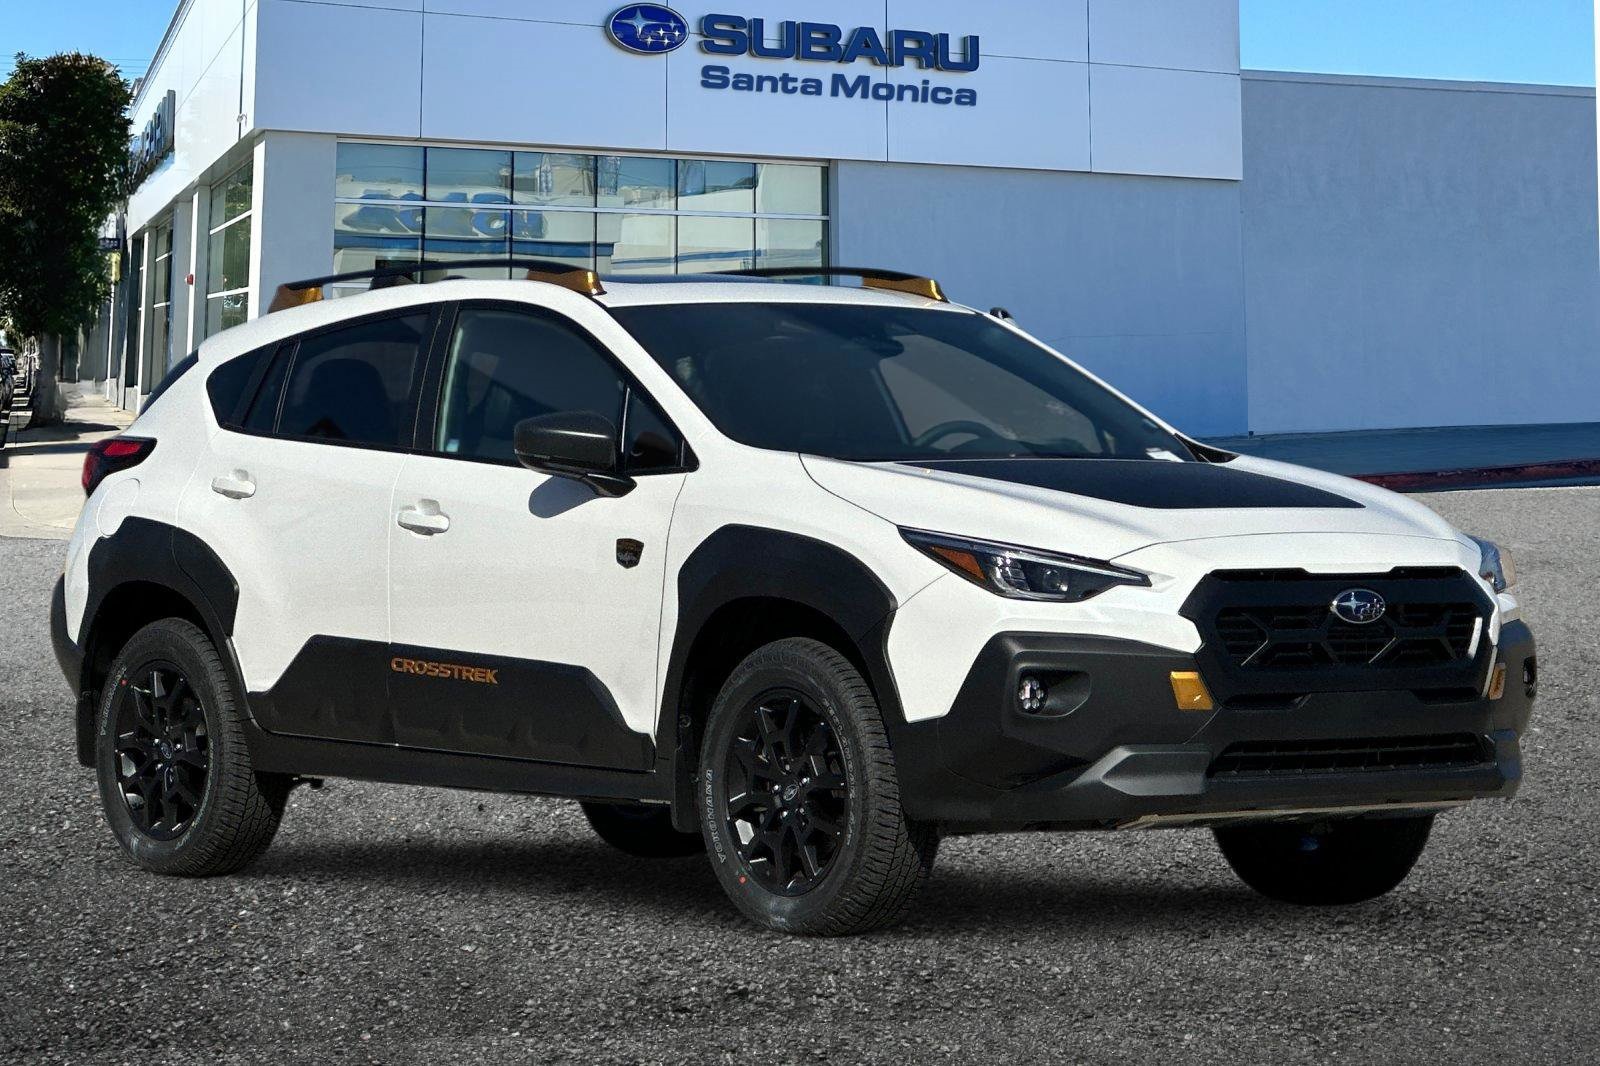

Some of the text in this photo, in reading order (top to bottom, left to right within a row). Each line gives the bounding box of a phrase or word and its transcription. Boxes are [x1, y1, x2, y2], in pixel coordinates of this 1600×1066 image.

[700, 13, 980, 72] SUBARU
[701, 65, 977, 107] Santa Monica
[390, 657, 499, 684] CROSSTREK
[705, 769, 727, 863] YOKOHAMA
